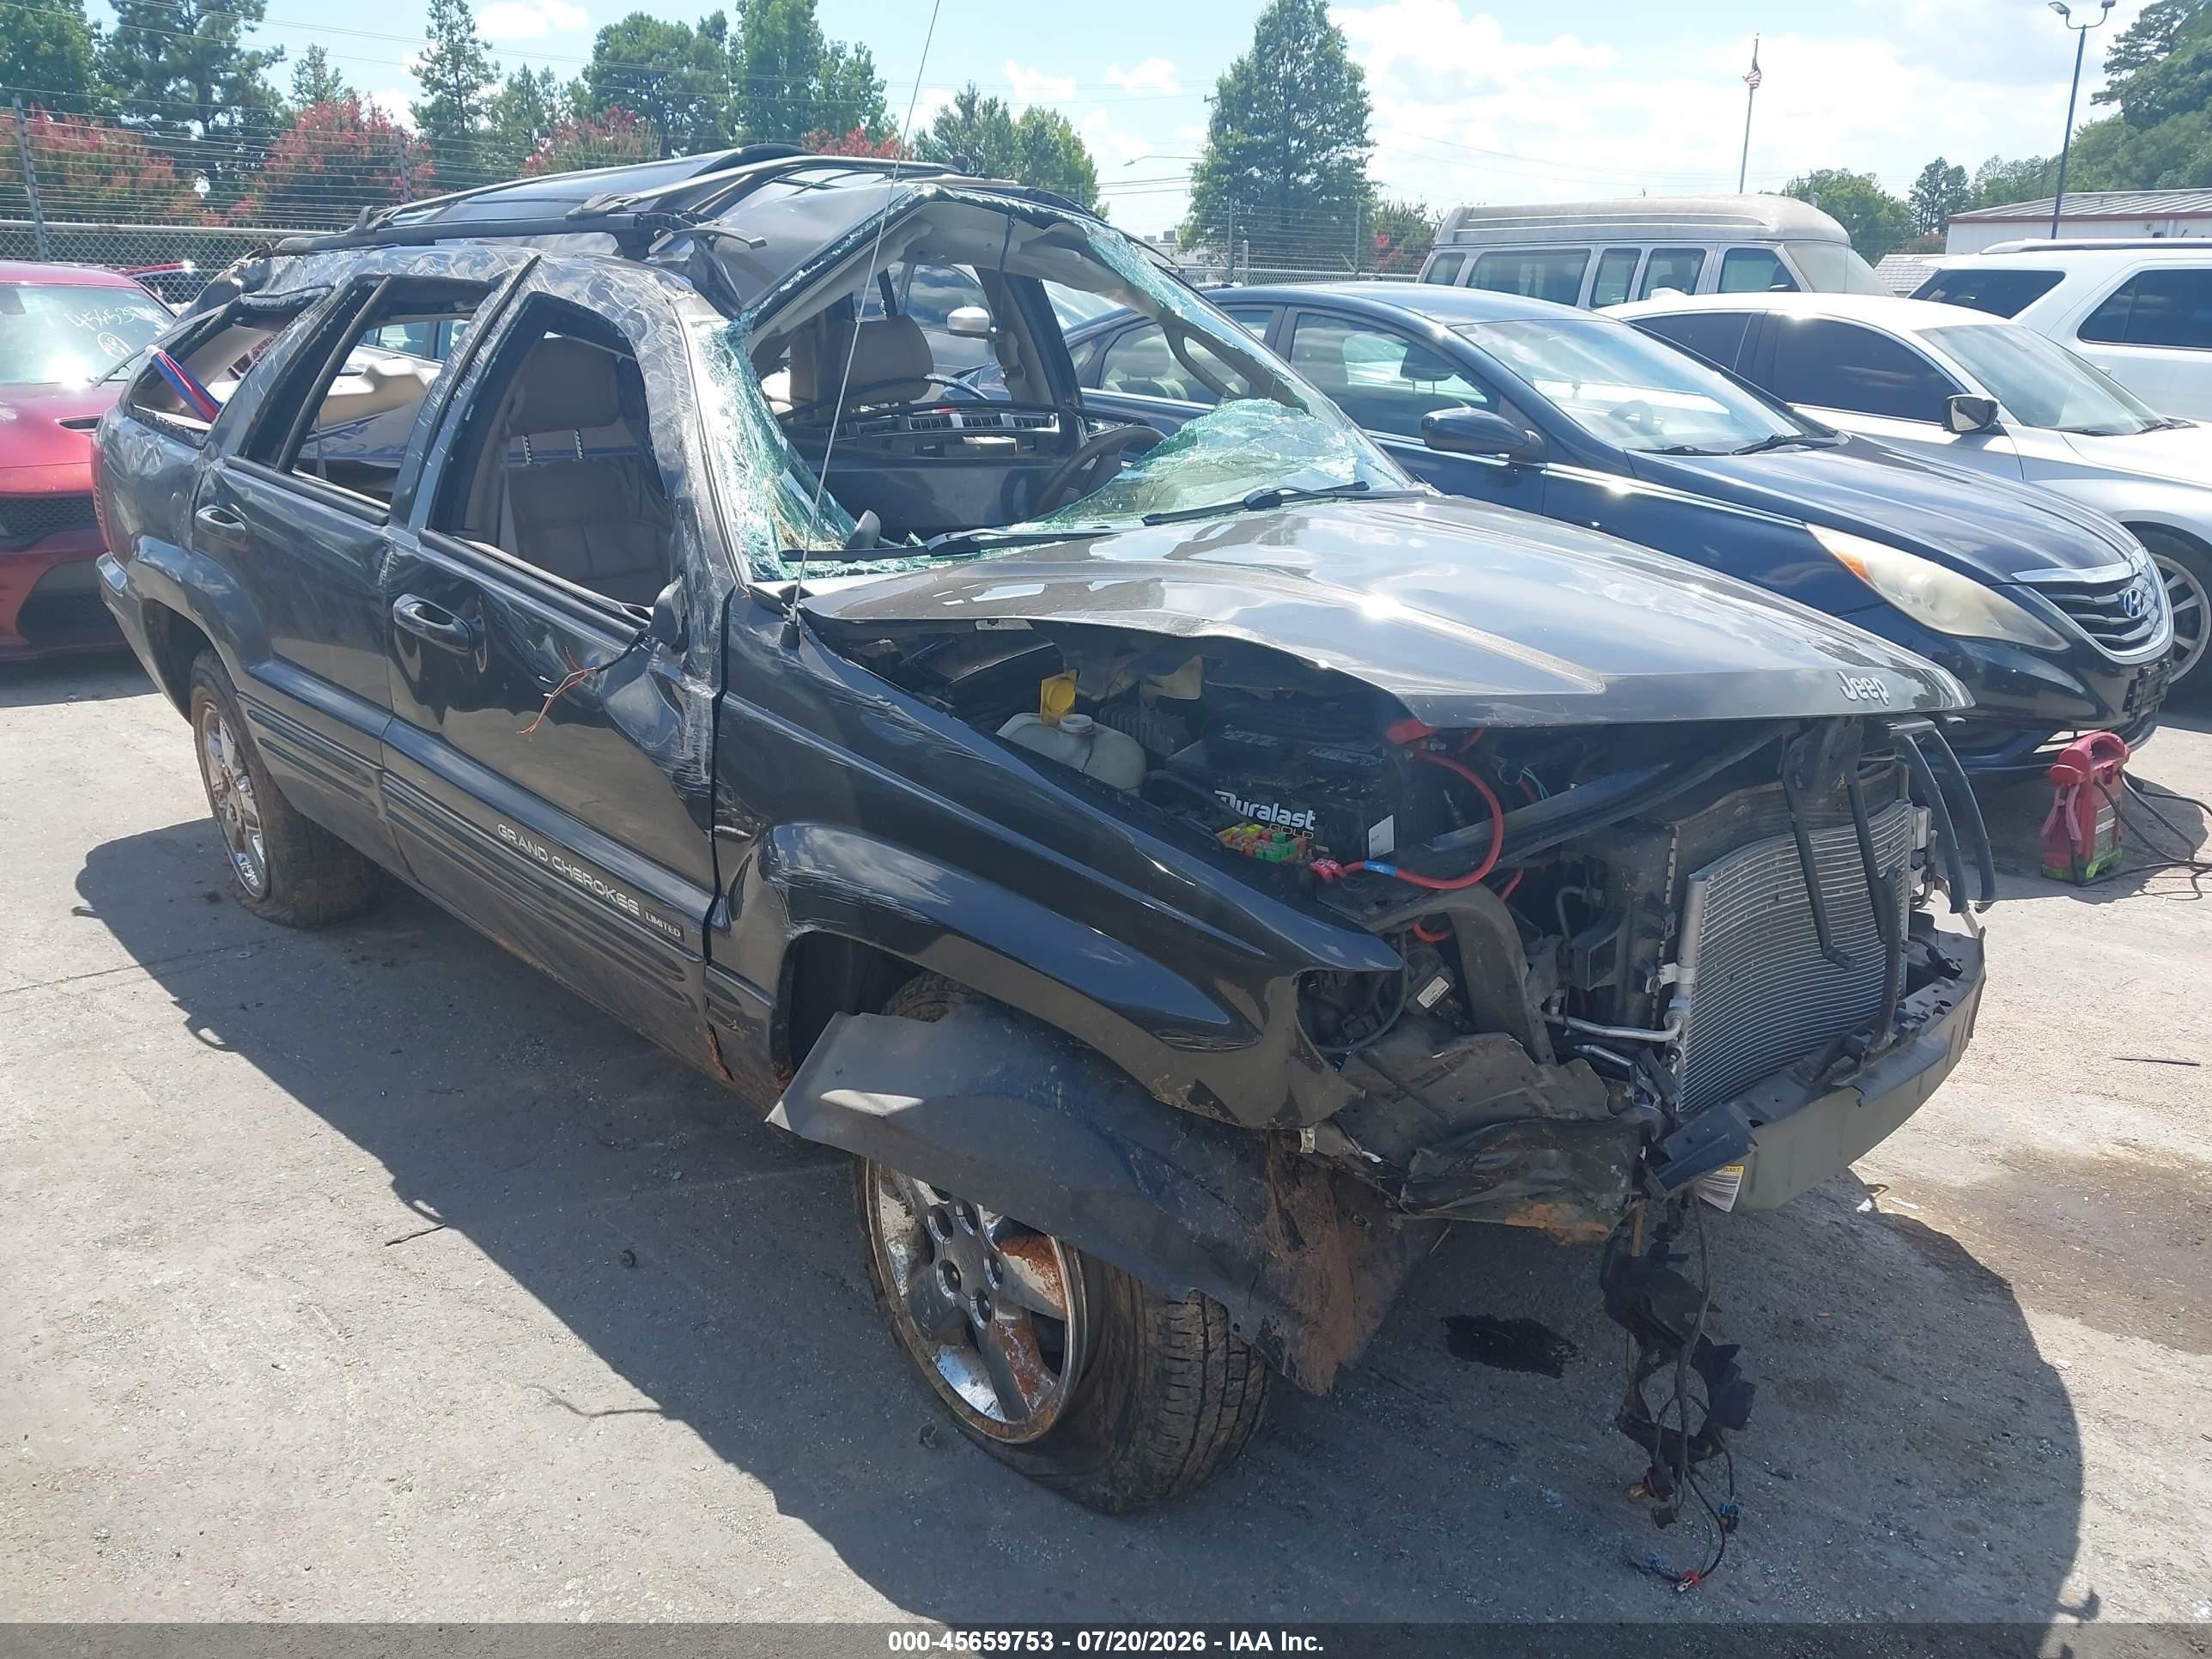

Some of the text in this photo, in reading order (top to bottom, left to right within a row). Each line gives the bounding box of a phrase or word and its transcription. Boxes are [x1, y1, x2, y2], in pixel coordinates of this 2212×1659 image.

[1837, 671, 1889, 706] Jeep
[1214, 790, 1316, 830] Duralast
[1268, 823, 1314, 839] GOLD
[497, 823, 681, 937] GRAND CHEROKEE LIMITED
